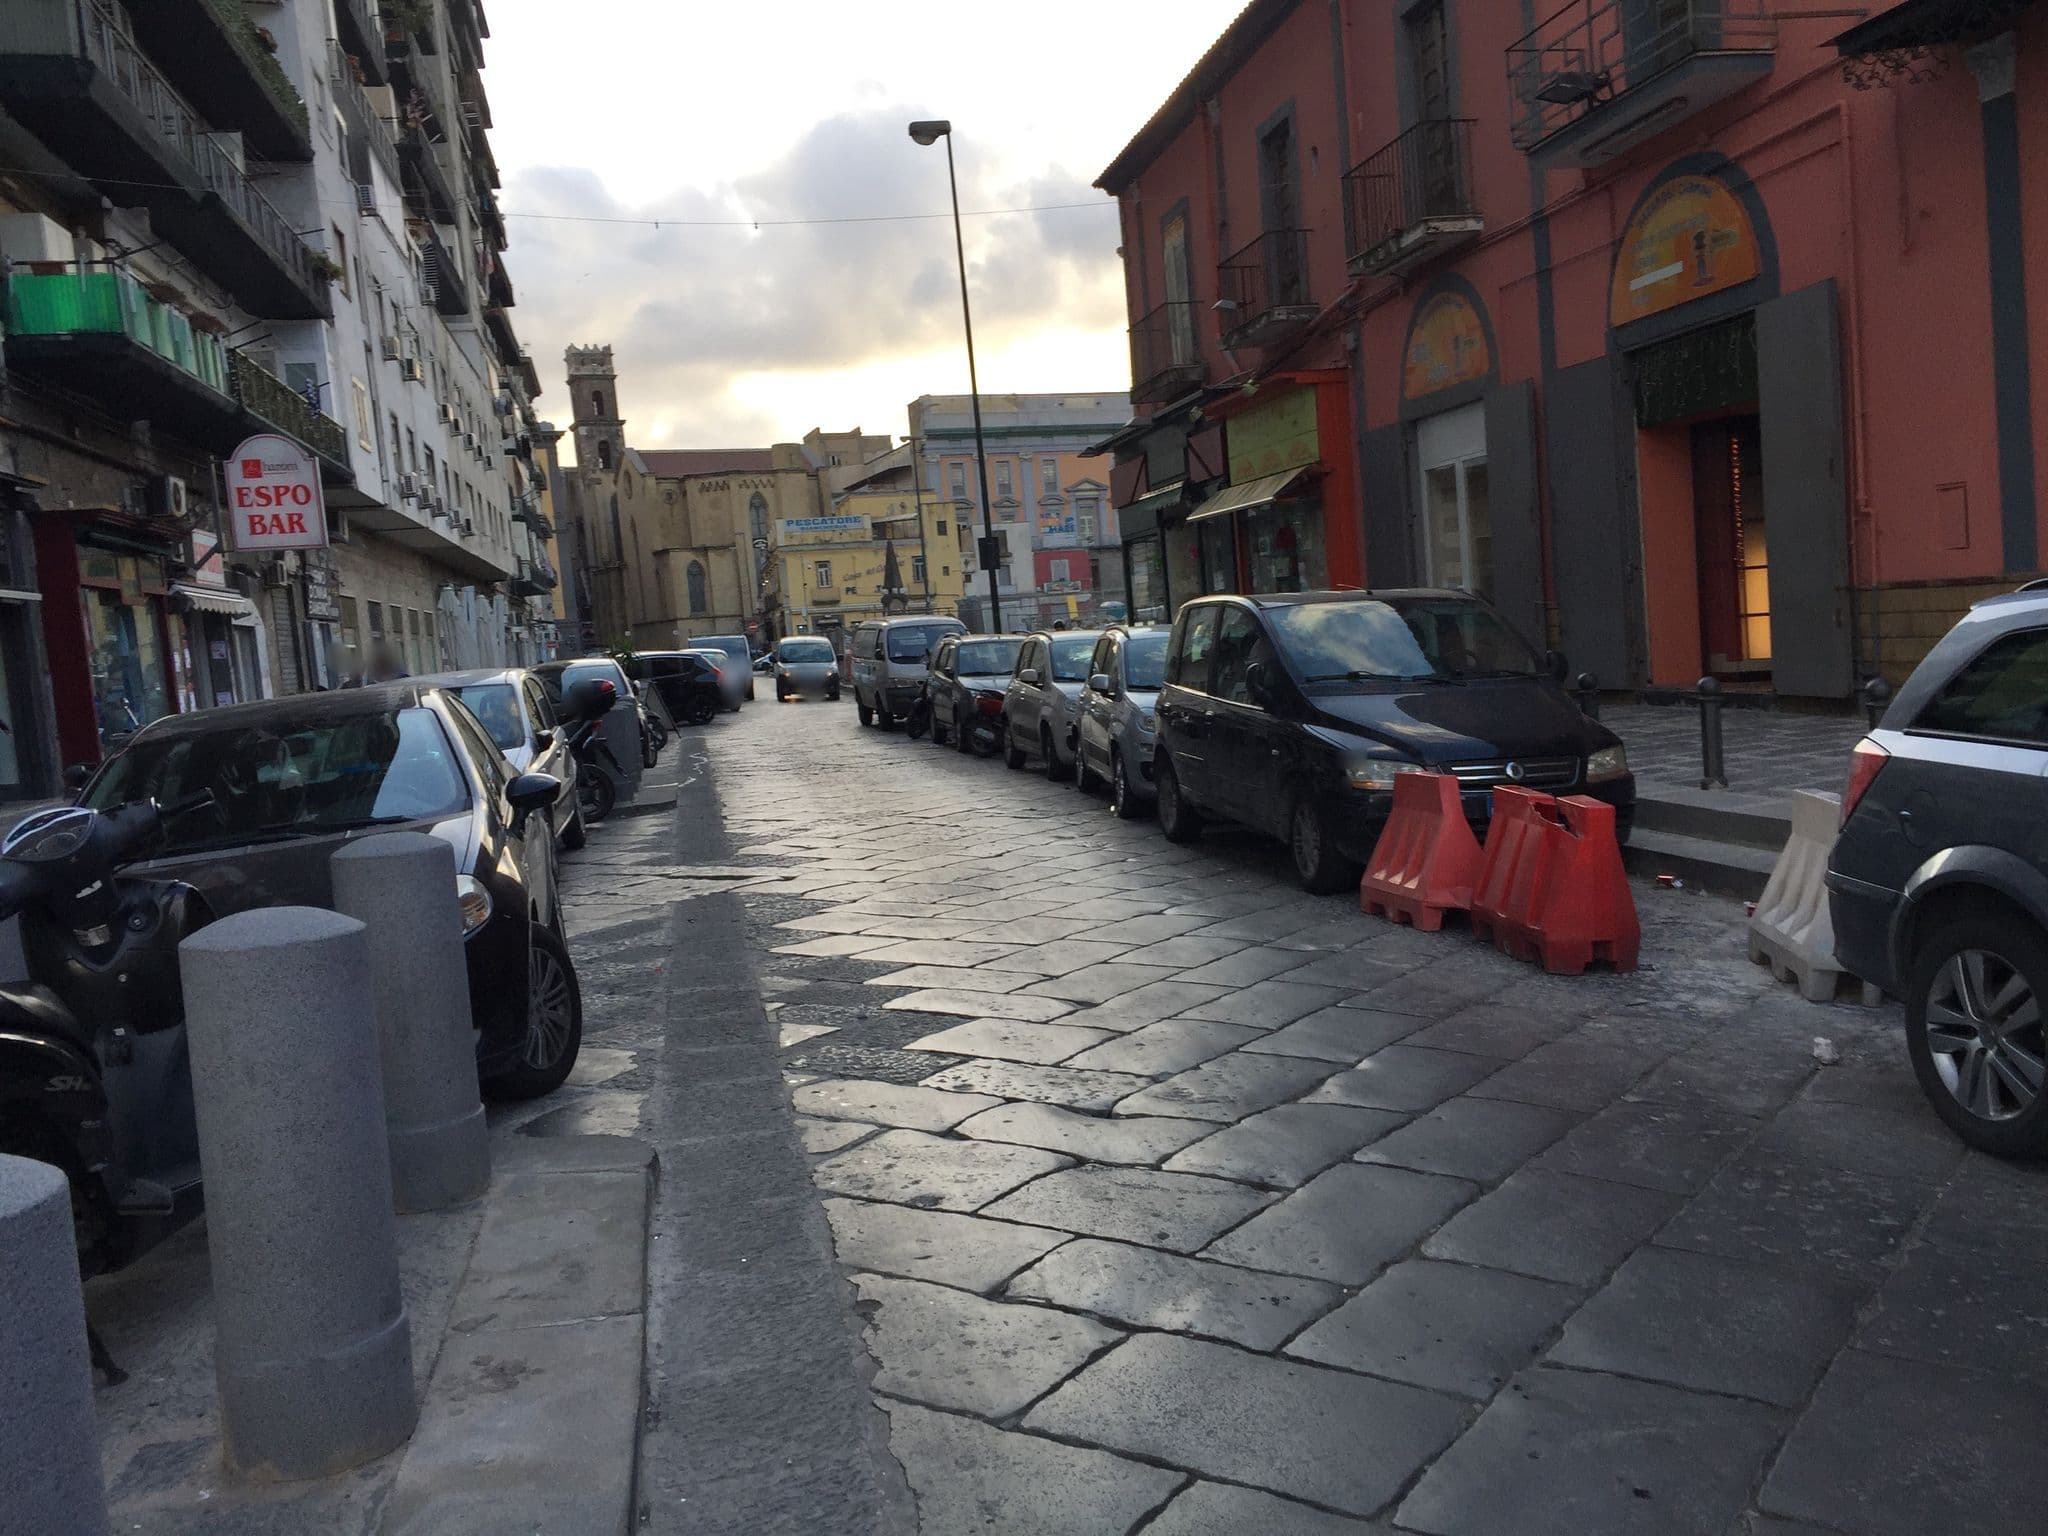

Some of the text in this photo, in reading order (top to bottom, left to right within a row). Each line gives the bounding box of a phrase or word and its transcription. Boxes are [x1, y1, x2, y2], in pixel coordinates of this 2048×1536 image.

[236, 484, 312, 508] ESPO
[248, 512, 308, 536] BAR
[785, 515, 861, 527] PESCATORE
